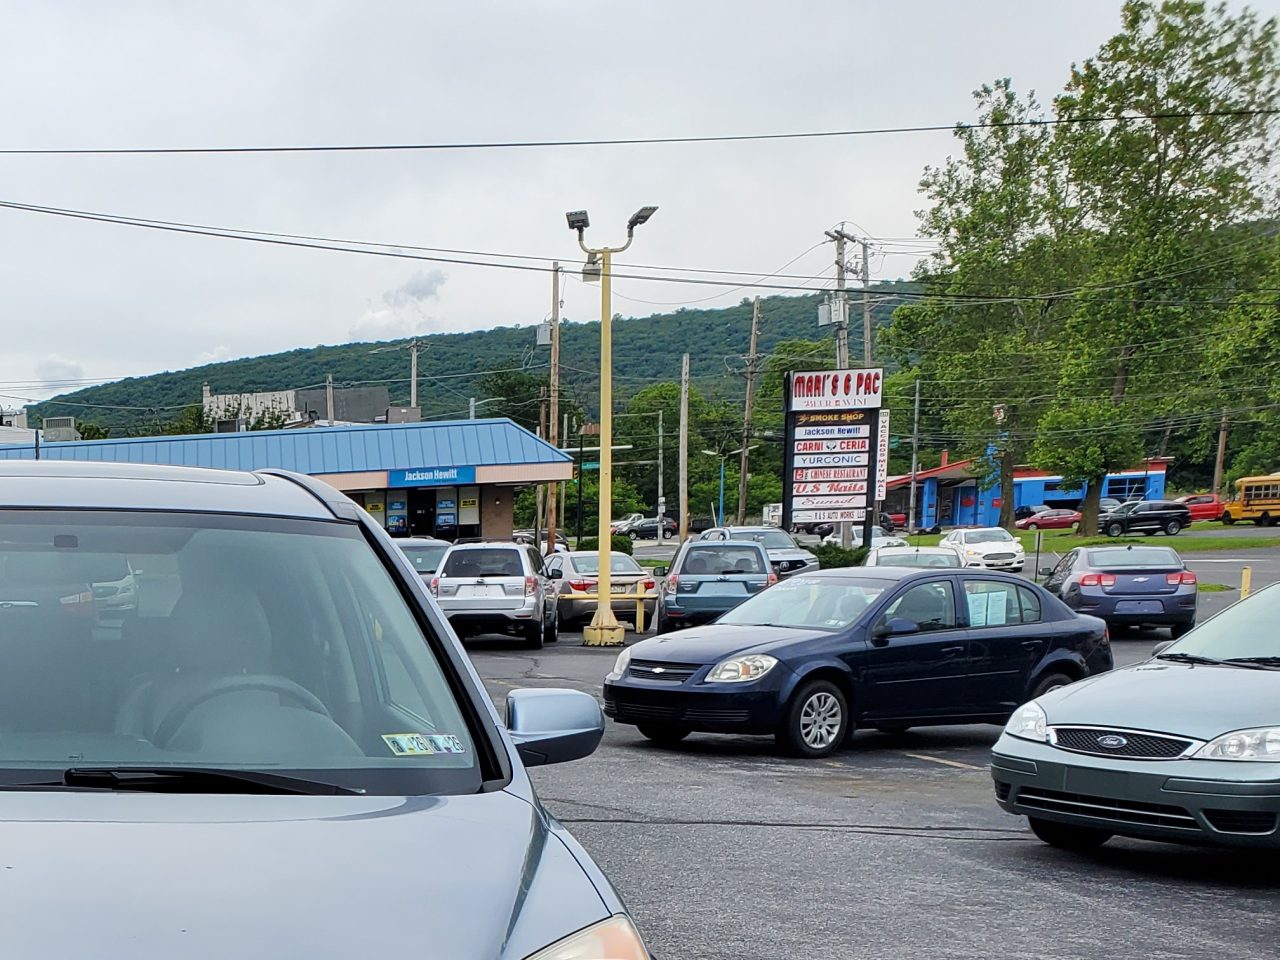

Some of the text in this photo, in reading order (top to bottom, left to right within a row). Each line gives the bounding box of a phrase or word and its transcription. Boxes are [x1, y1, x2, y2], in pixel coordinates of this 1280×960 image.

[856, 371, 881, 396] PAC
[810, 414, 839, 422] SMOKE
[841, 413, 865, 421] SHOP
[804, 426, 861, 436] Jackson Hewitt
[796, 440, 867, 452] CARNI CERIA
[801, 455, 862, 464] YURCONIC
[404, 470, 433, 481] Jackson
[433, 468, 457, 480] Hewitt
[833, 468, 866, 479] RESTAURANT
